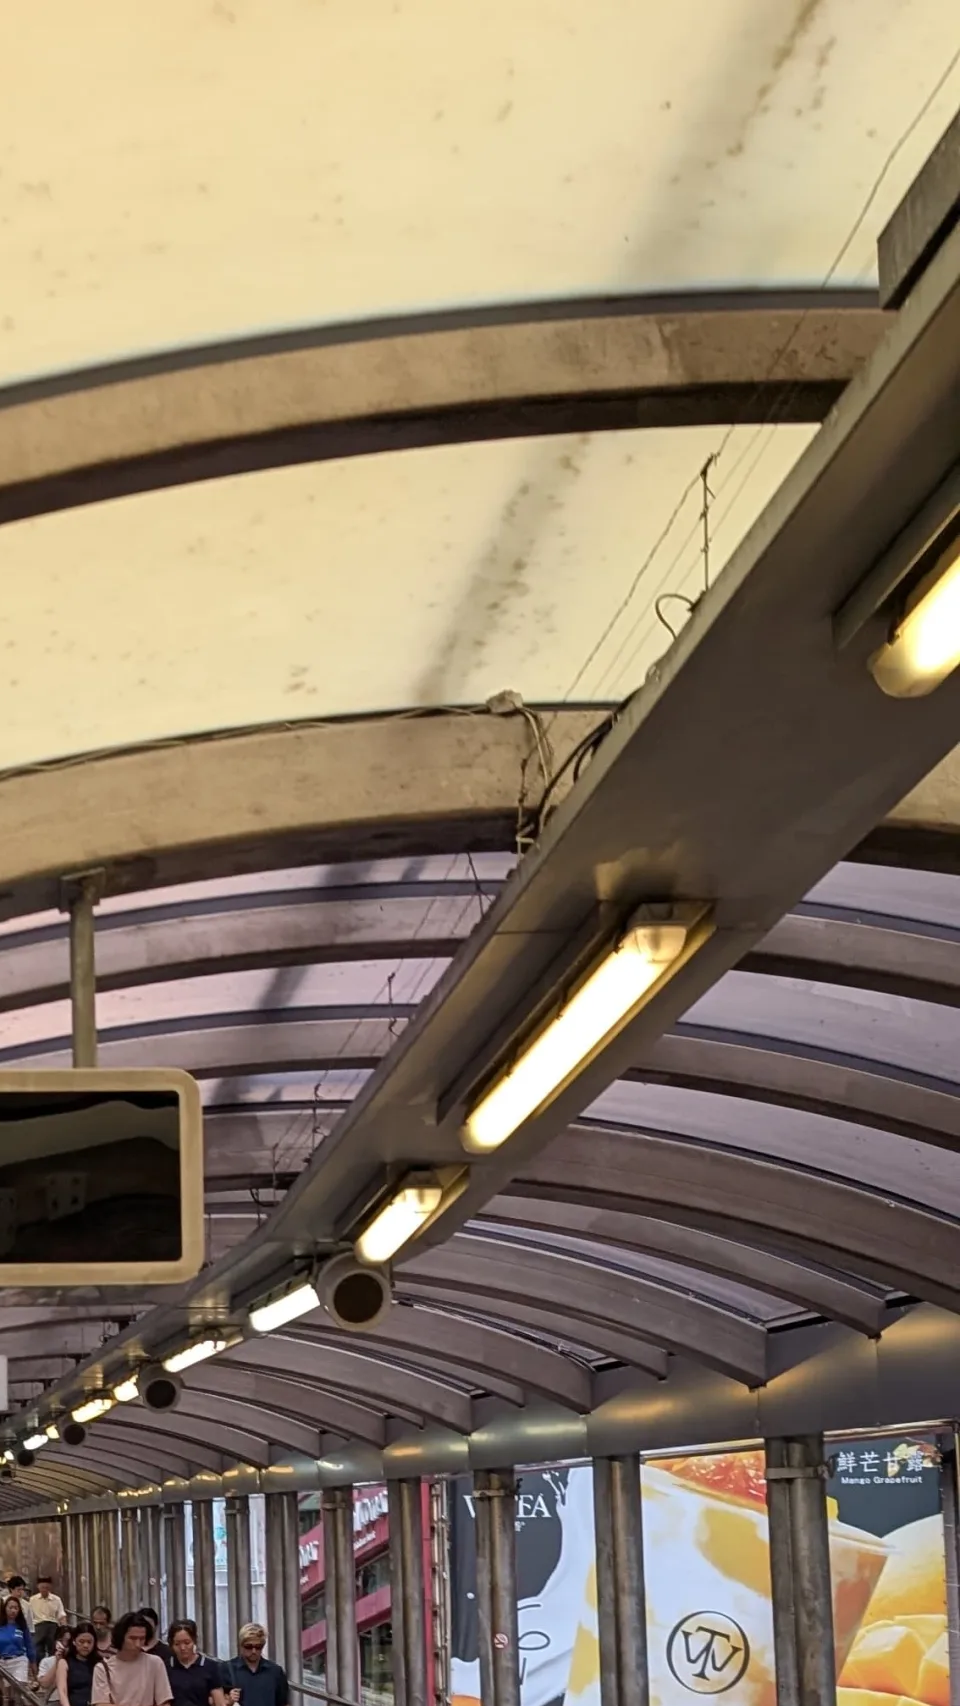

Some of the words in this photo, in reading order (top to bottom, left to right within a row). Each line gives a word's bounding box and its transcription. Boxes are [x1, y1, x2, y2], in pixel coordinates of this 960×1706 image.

[837, 1451, 924, 1474] 鮮芒甘露
[841, 1476, 871, 1485] Mango
[873, 1476, 923, 1485] Grapefruit
